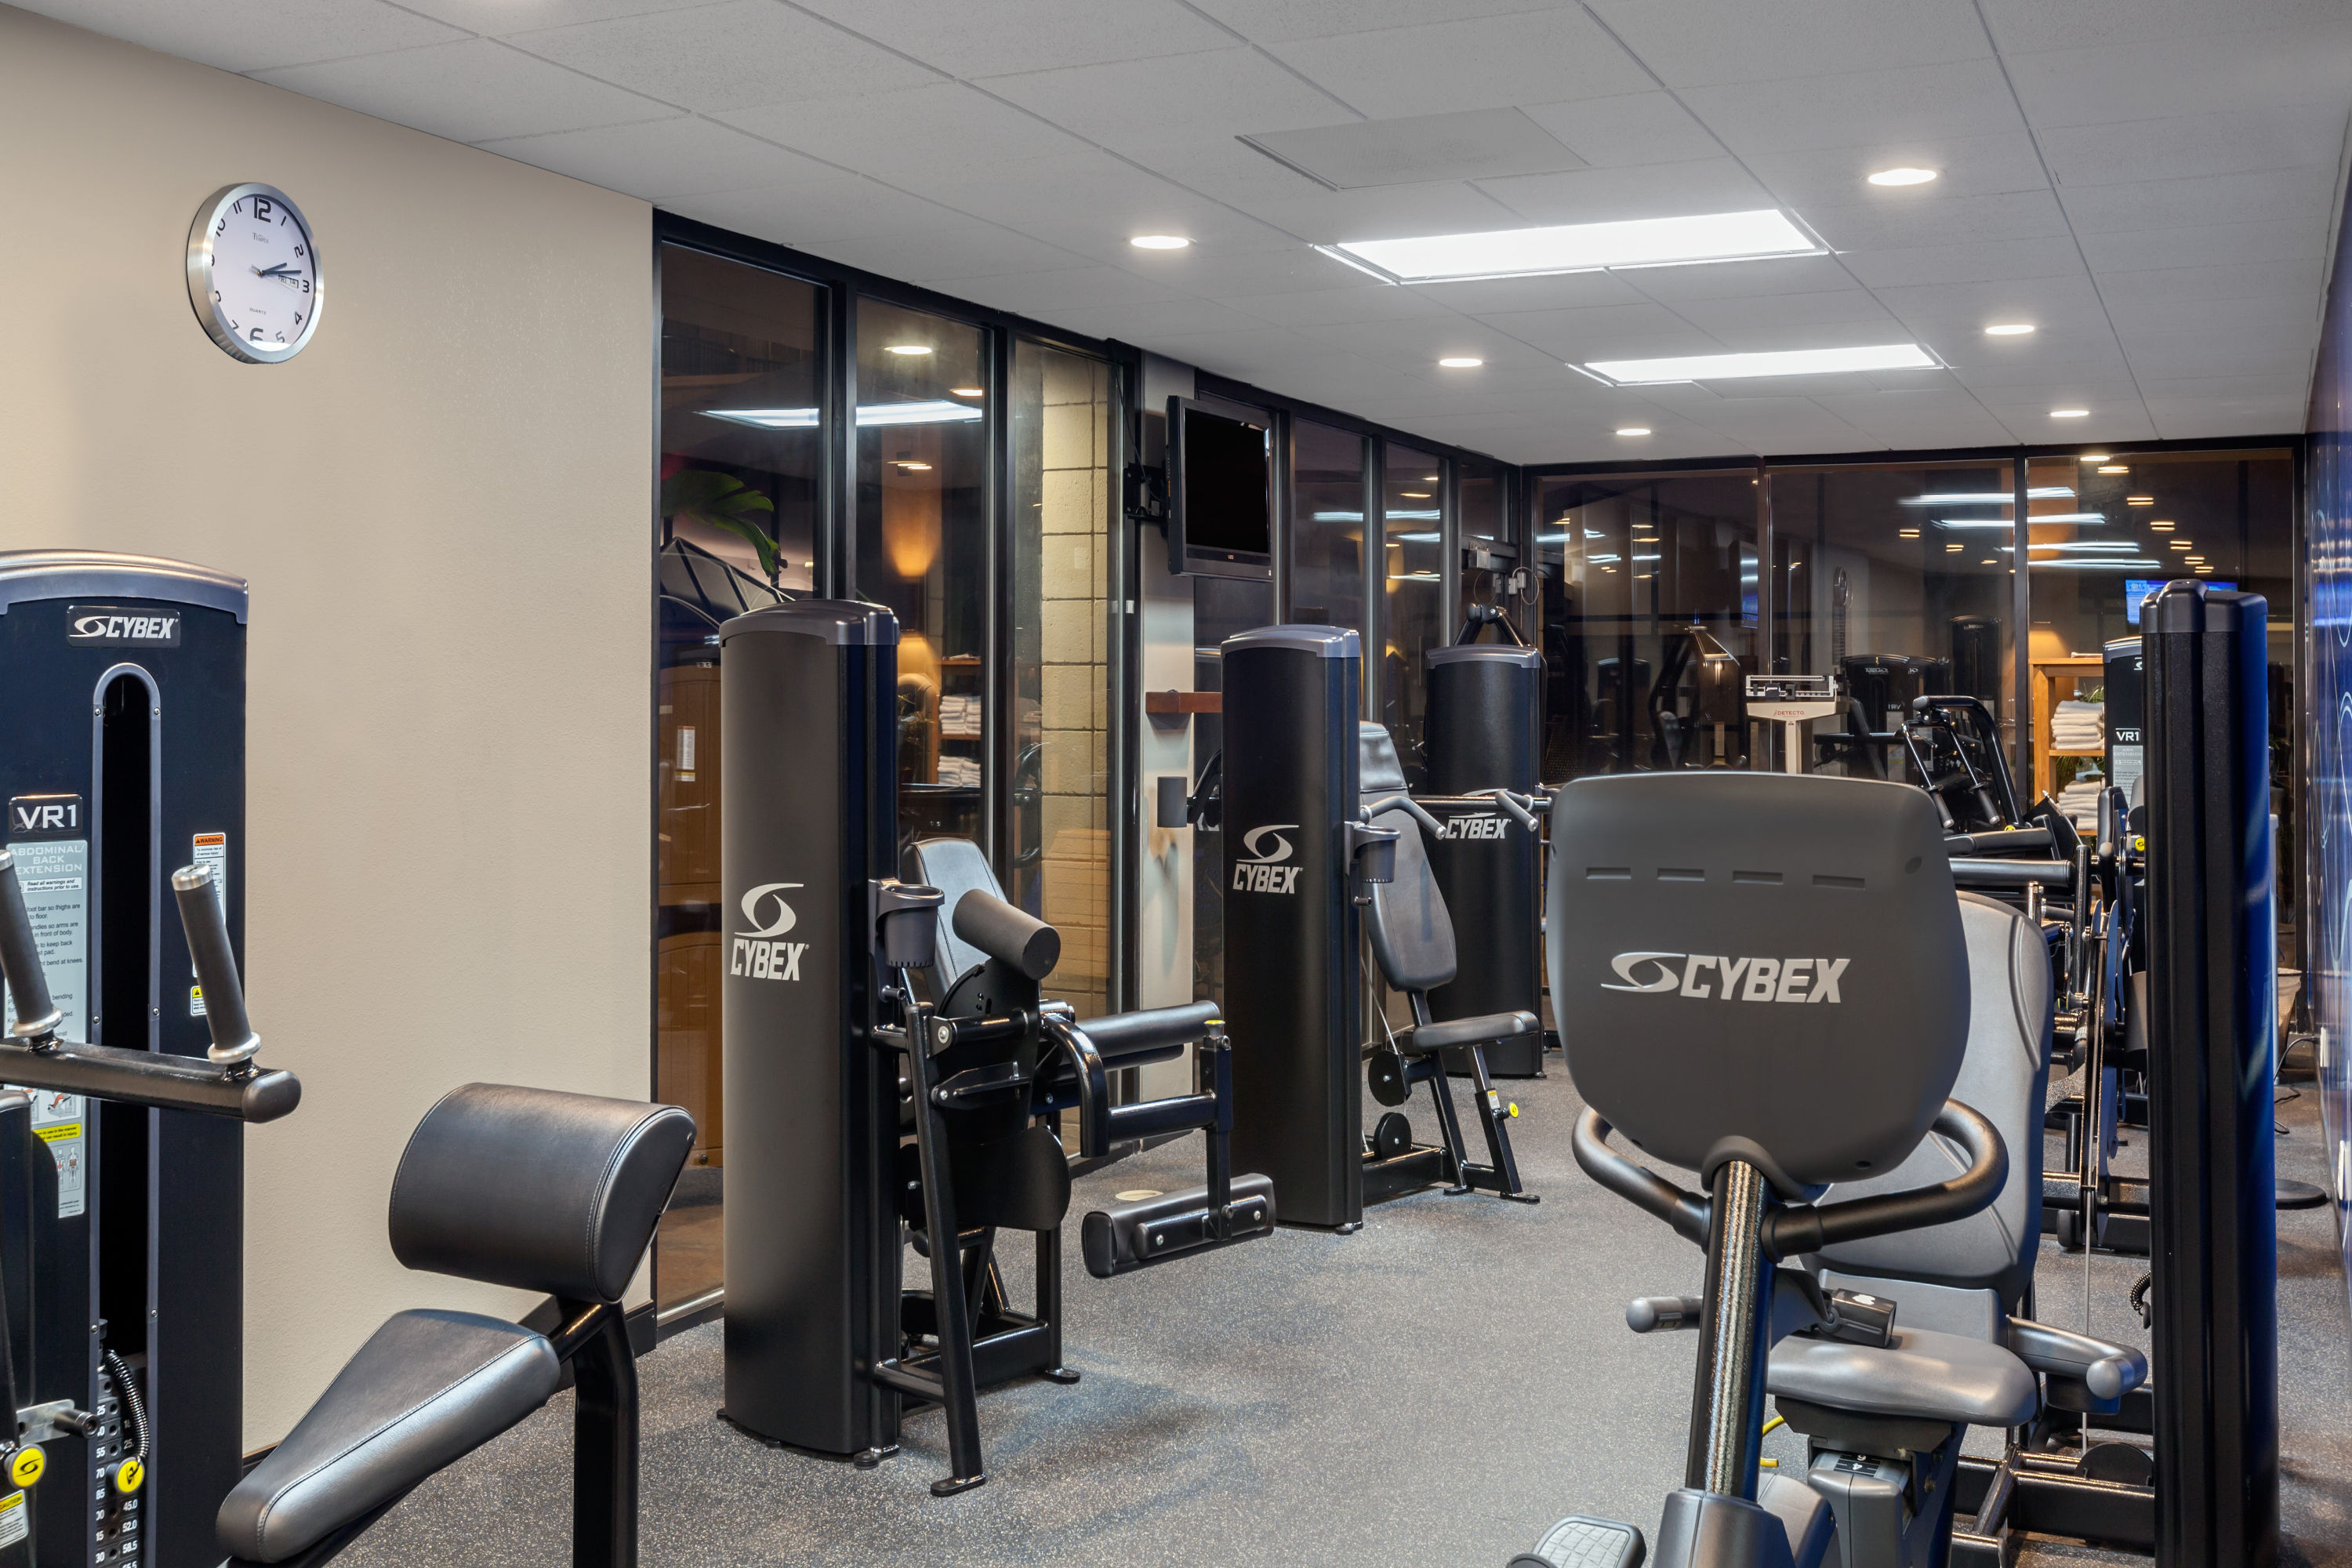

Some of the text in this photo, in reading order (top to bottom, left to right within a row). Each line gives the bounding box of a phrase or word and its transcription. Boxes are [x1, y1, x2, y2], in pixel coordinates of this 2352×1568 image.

[233, 200, 242, 214] 11
[254, 197, 271, 223] 12
[281, 216, 287, 227] 1
[294, 244, 304, 258] 2
[303, 279, 310, 293] 3
[295, 311, 303, 325] 4
[249, 327, 263, 342] 6
[275, 331, 285, 343] 5
[106, 616, 175, 639] CYBEX
[2116, 731, 2140, 742] VR1
[16, 804, 77, 829] VR1
[1444, 818, 1509, 840] CYBEX
[11, 845, 85, 856] ABDOMINAL/
[33, 855, 65, 865] BACK
[16, 863, 82, 875] EXTENSION
[1232, 863, 1301, 894] CYBEX
[730, 938, 806, 982] CYBEX
[1679, 954, 1851, 1004] CYBEX
[96, 1405, 106, 1416] 25
[96, 1446, 106, 1458] 55
[96, 1467, 105, 1479] 70
[96, 1488, 105, 1500] 85
[123, 1498, 138, 1512] 45.0
[122, 1519, 138, 1533] 52.0
[122, 1540, 138, 1554] 58.5
